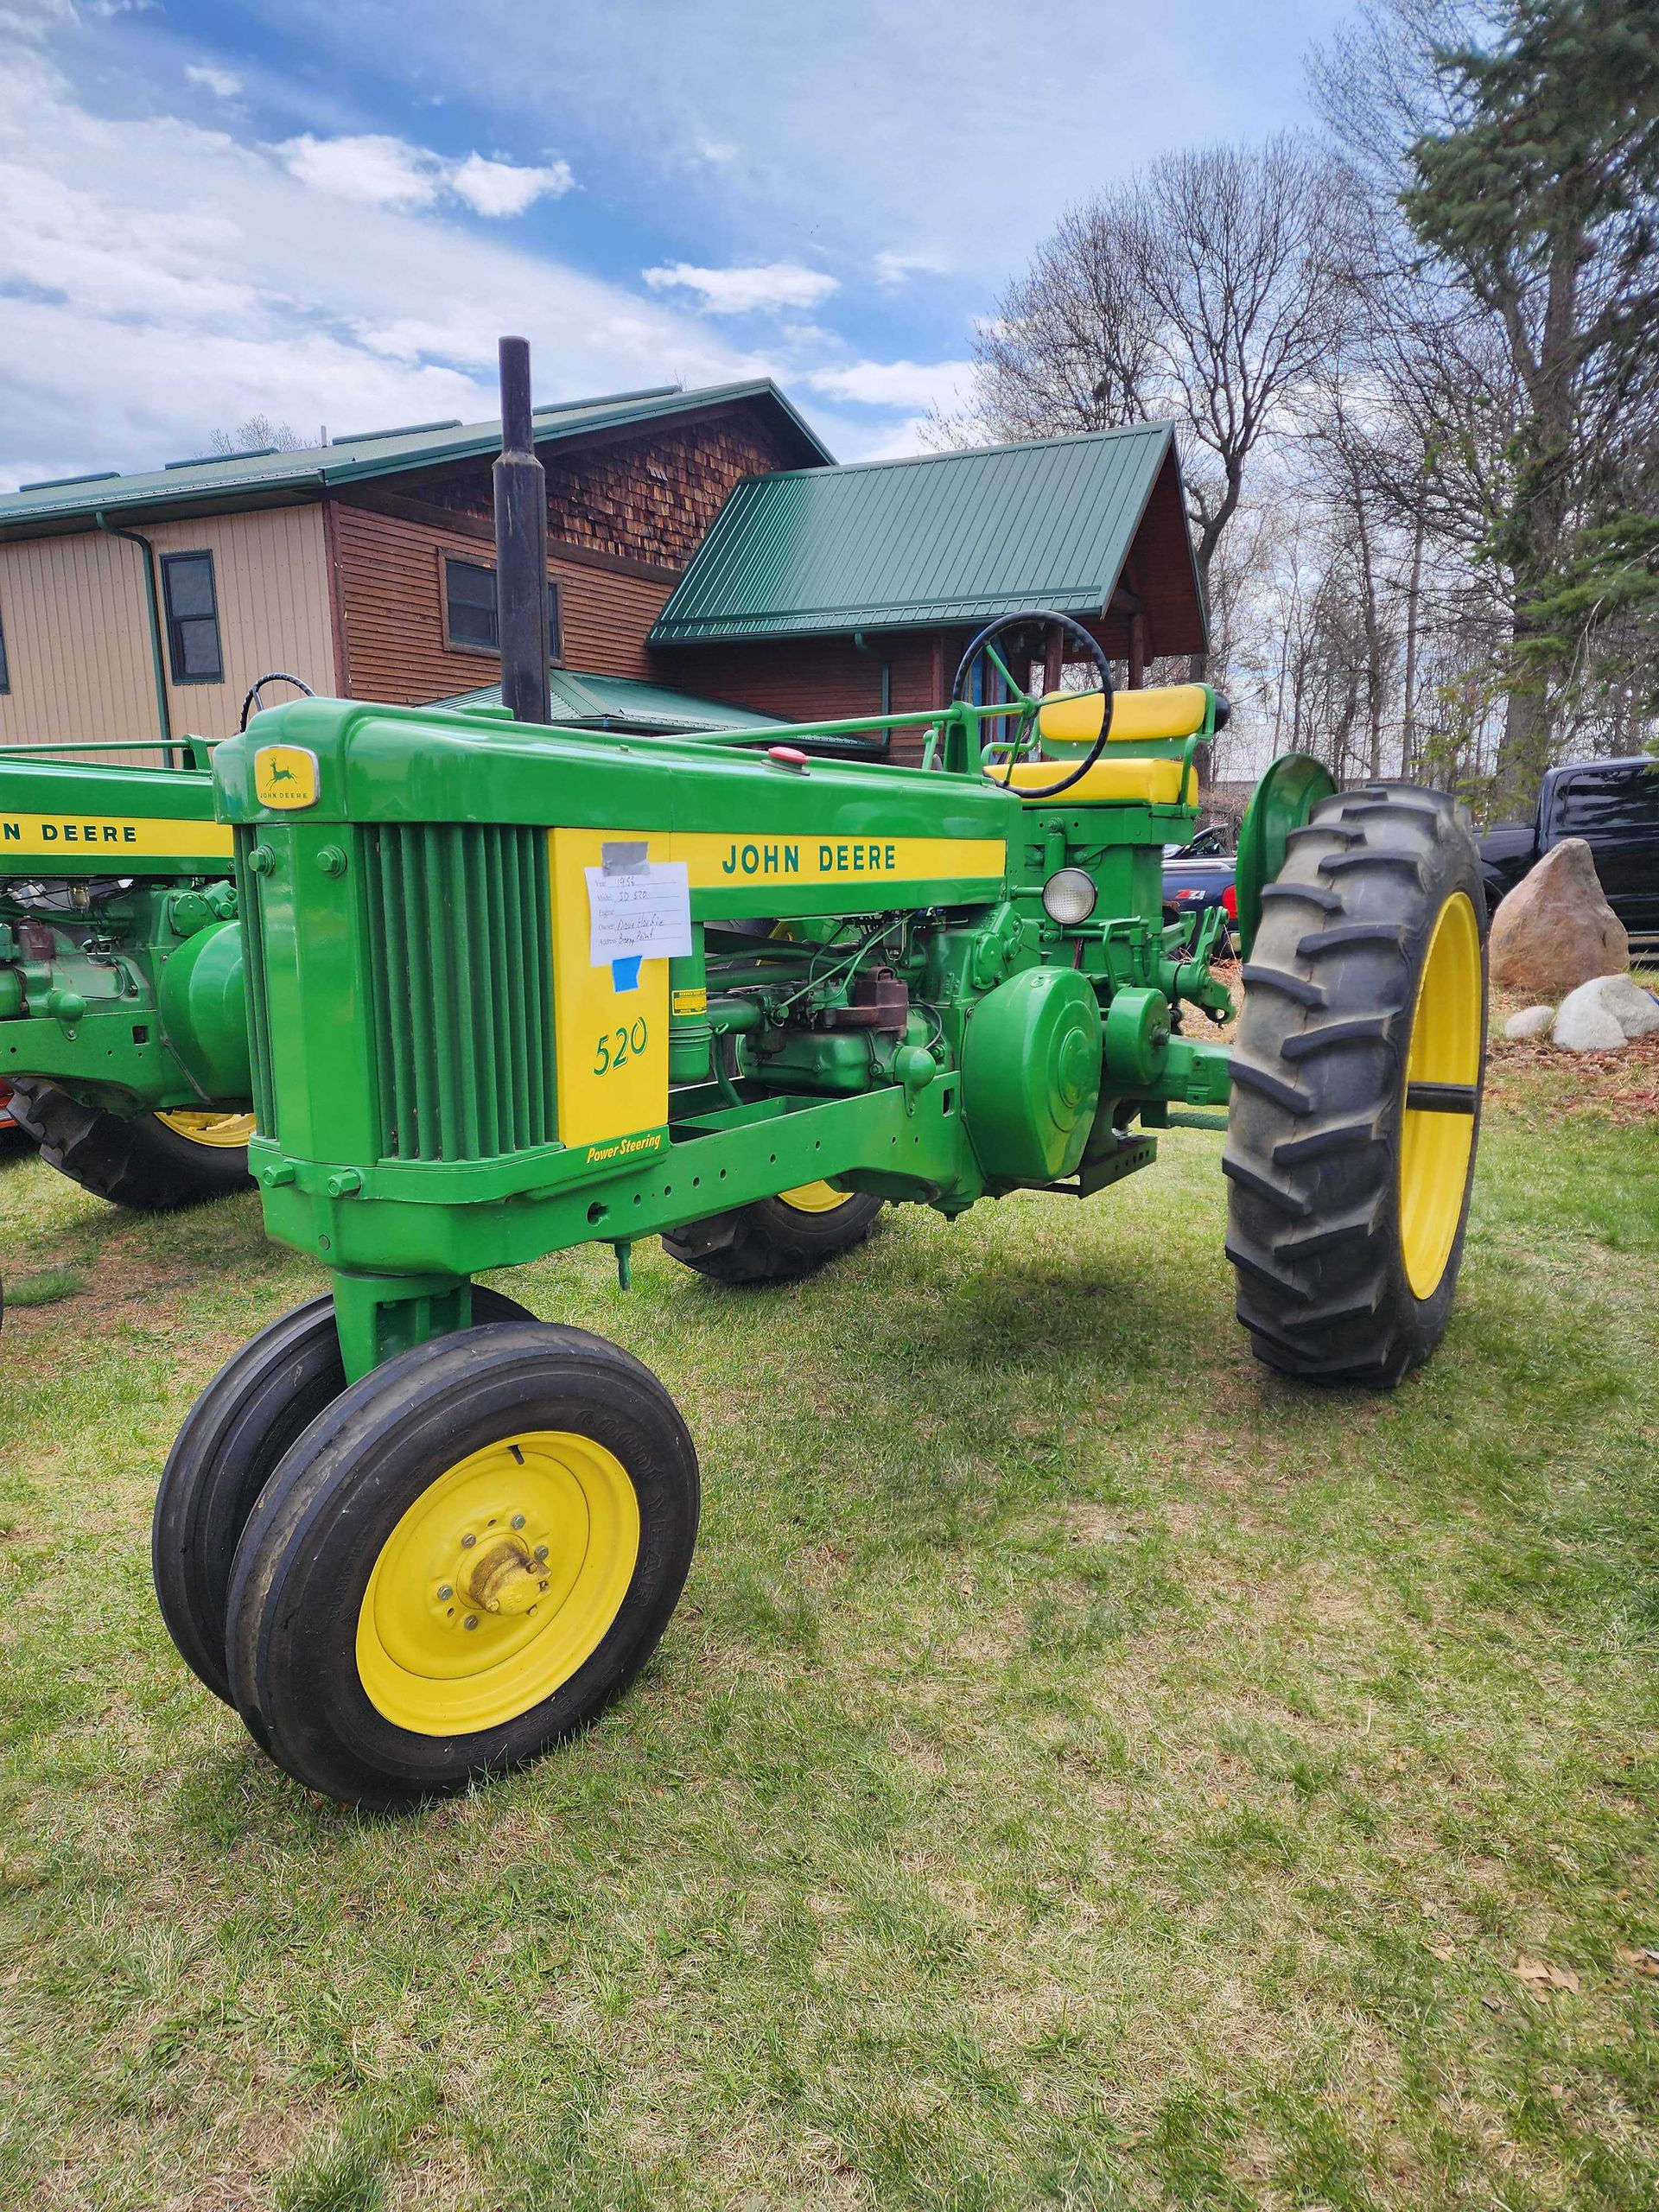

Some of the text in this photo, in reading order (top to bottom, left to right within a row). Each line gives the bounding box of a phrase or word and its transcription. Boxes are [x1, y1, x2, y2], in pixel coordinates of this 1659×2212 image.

[41, 824, 137, 842] DEERE
[721, 844, 896, 874] JOHN DEERE
[593, 1016, 648, 1077] 520
[586, 1134, 662, 1164] Power Steering
